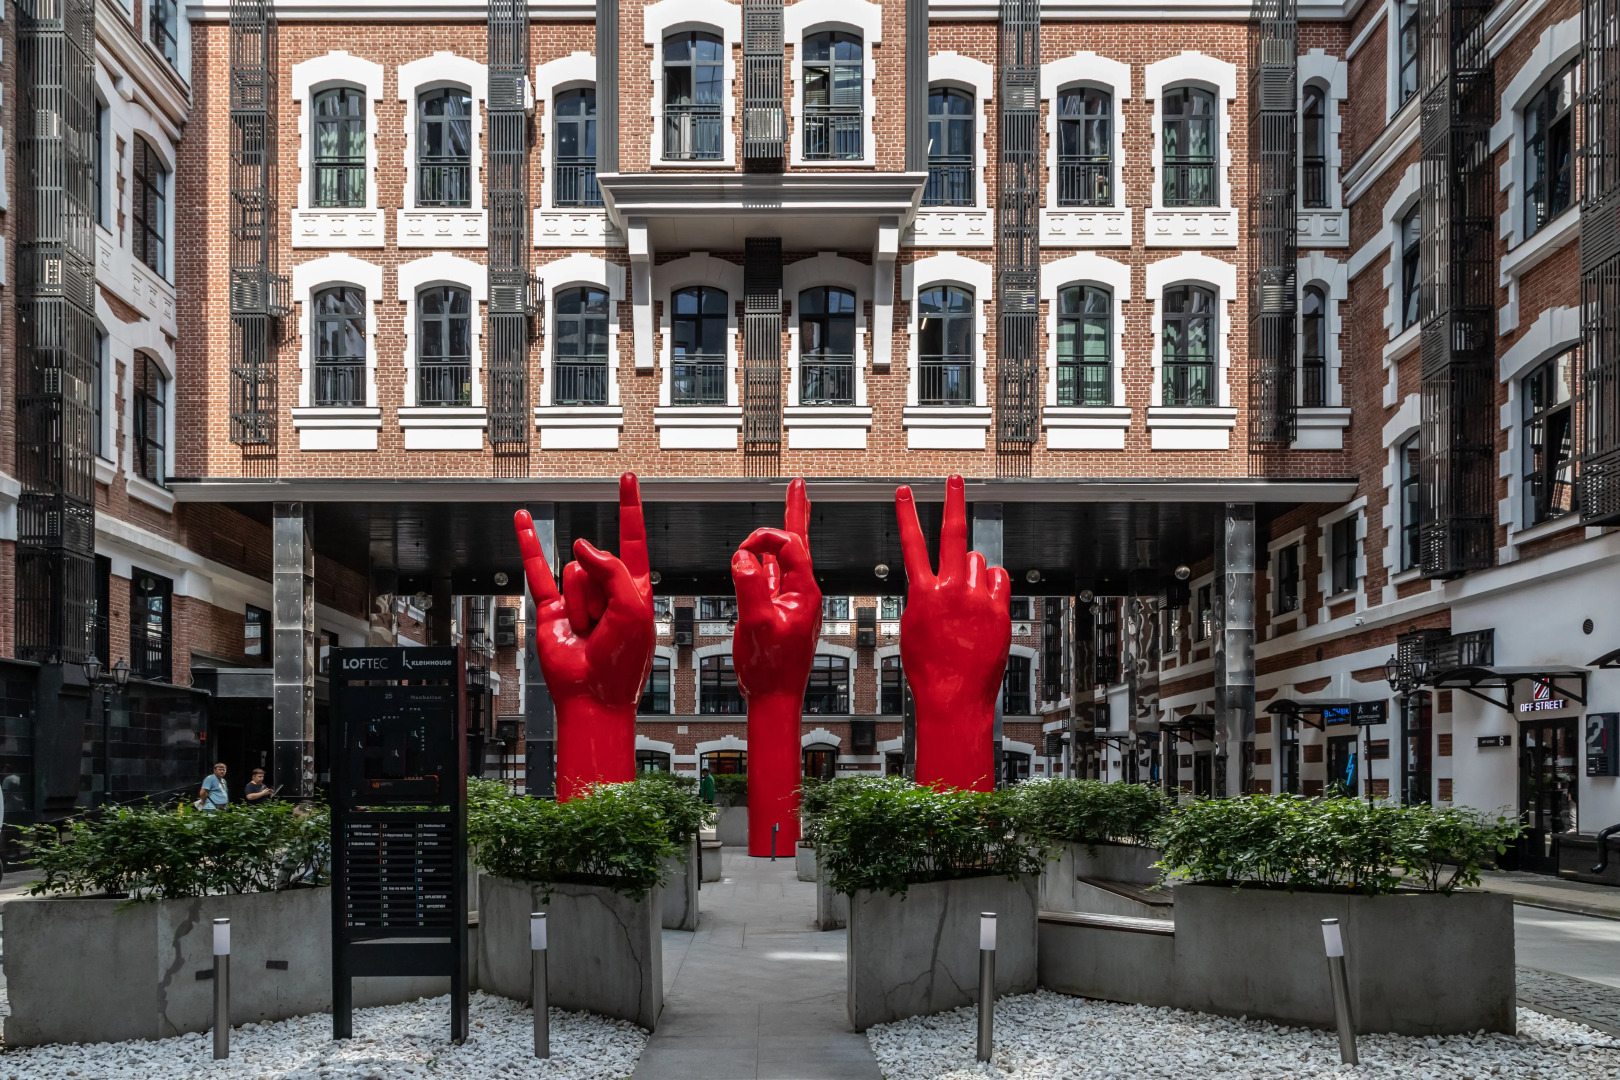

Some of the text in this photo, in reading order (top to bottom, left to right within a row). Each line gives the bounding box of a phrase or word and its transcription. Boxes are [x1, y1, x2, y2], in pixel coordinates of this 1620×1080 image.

[343, 658, 389, 669] LOFTEC
[1520, 700, 1563, 712] OFF STREET
[1587, 715, 1604, 754] 2
[1499, 736, 1504, 746] 6
